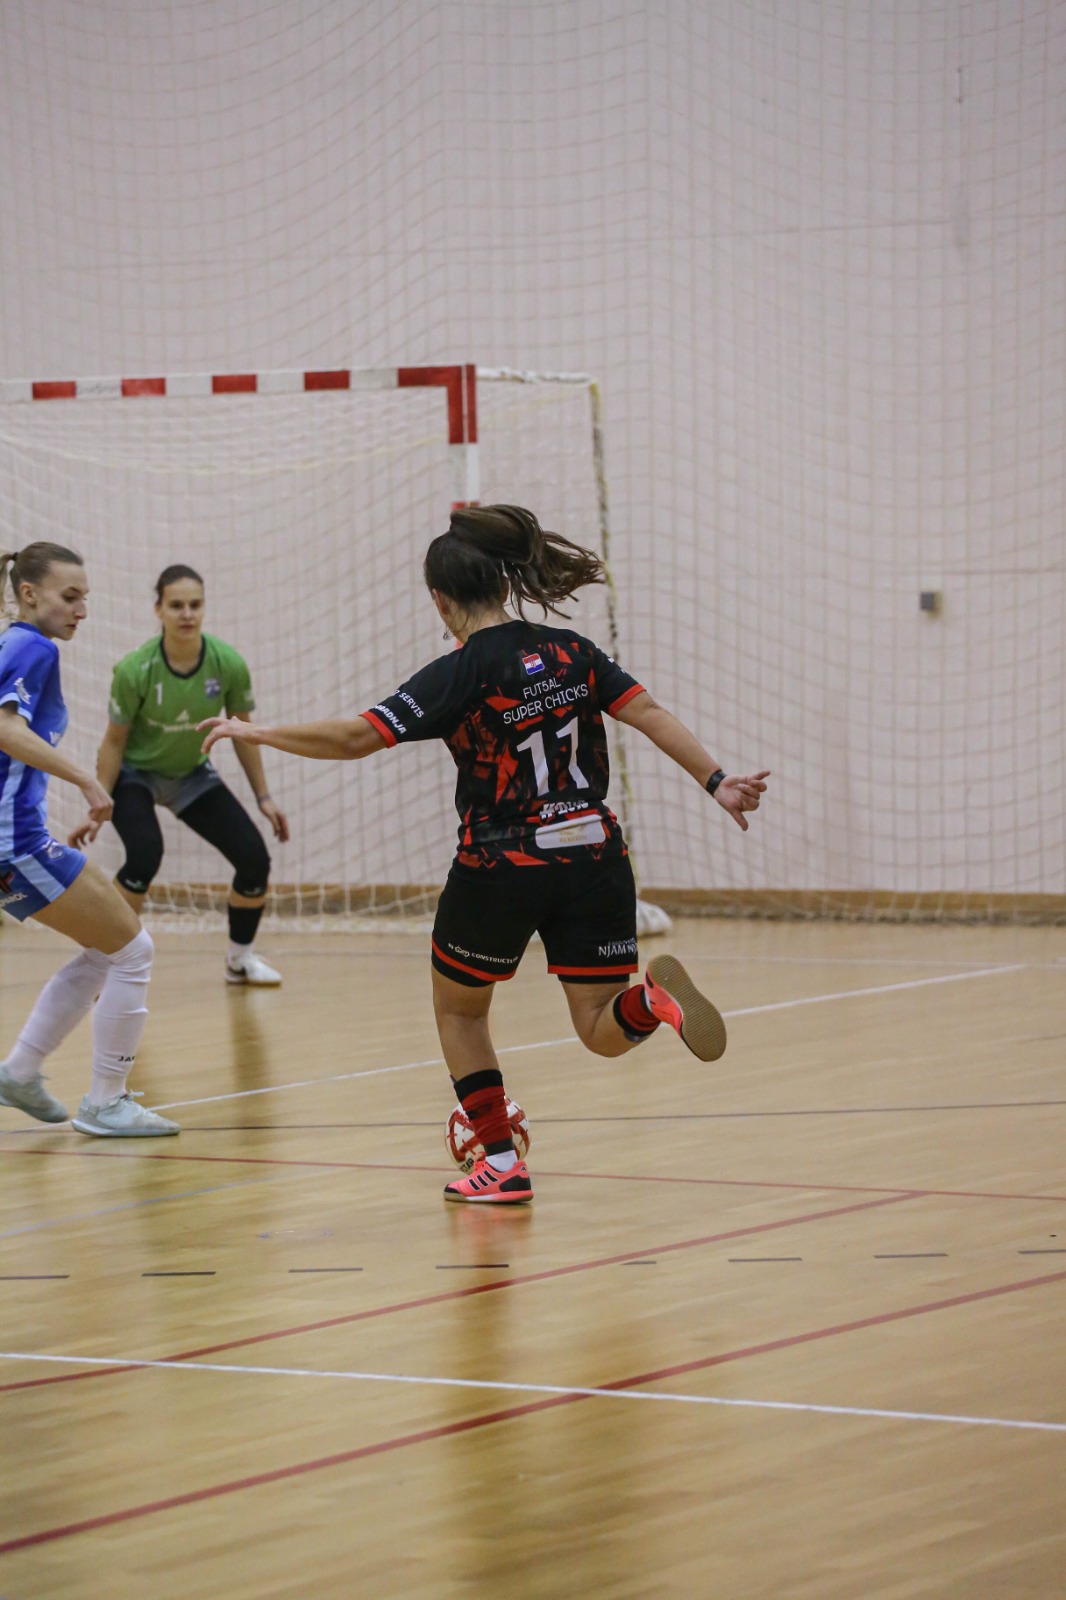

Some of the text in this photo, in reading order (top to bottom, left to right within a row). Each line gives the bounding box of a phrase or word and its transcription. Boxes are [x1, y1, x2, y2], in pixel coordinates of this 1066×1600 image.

[155, 681, 163, 706] 1
[398, 692, 425, 718] SERVIS
[503, 684, 589, 724] SUPER CHICKS
[516, 716, 590, 797] 11
[598, 944, 627, 958] NJAM
